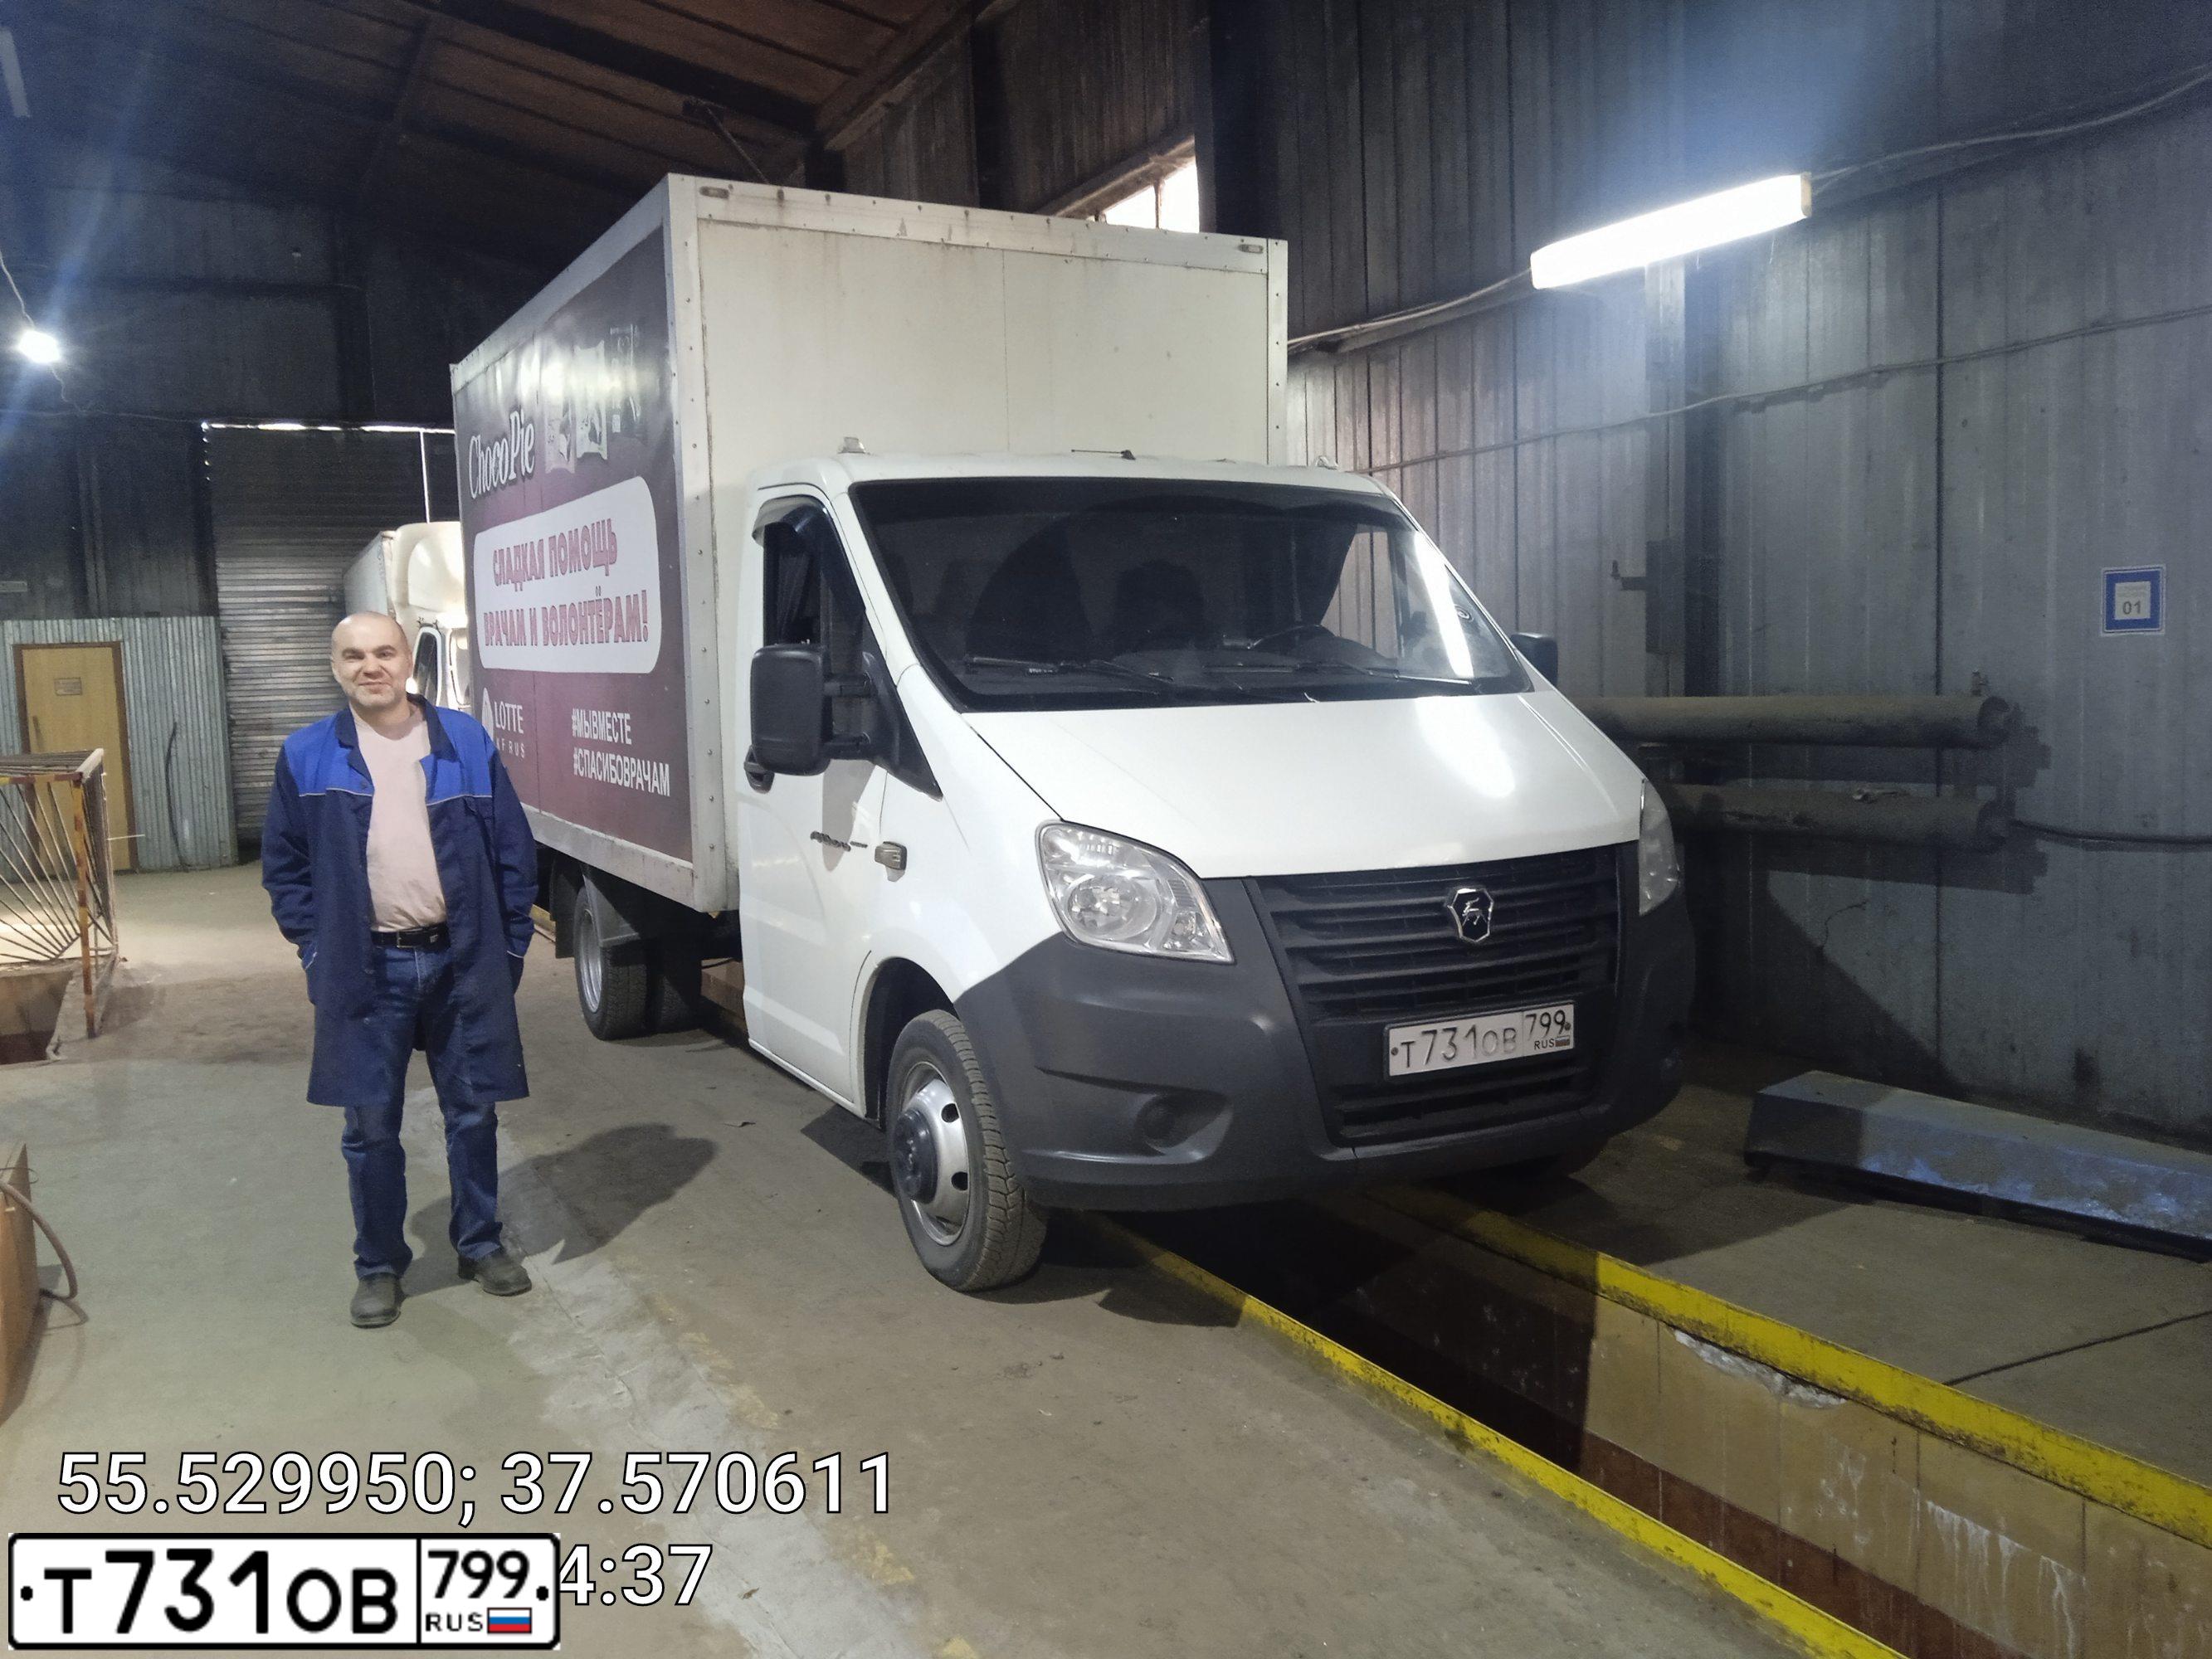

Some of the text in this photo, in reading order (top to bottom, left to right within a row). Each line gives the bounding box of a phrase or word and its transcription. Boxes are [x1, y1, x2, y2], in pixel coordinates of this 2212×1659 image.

[493, 518, 618, 592] СЛАДКАЯ ПОМОЩЬ
[484, 585, 648, 646] ВРАЧАМ И ВОЛОНТЁРАМ!
[2122, 600, 2141, 615] 01
[495, 701, 524, 734] LOTTE
[572, 708, 632, 745] #МЫВМЕСТЕ
[573, 747, 670, 796] #СПАСИБОВРАЧАМ
[1525, 1010, 1566, 1040] 799
[1534, 1038, 1554, 1050] RUS
